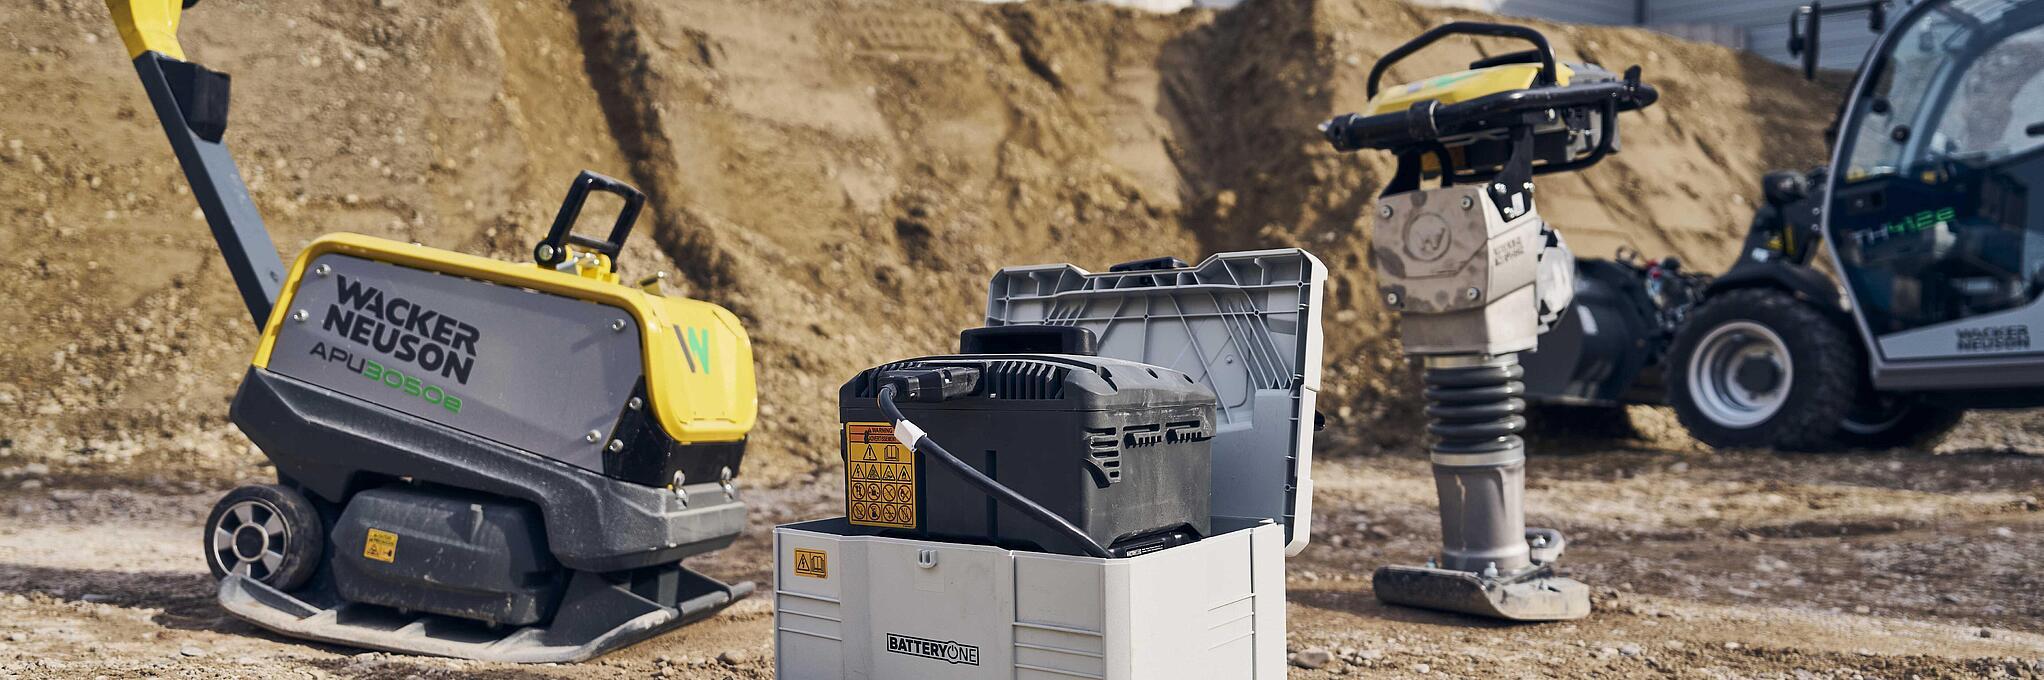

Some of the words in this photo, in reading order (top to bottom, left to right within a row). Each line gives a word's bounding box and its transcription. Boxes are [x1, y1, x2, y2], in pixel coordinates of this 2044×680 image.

[322, 303, 475, 386] NEUSON
[337, 274, 480, 357] WACKER
[309, 341, 463, 414] APU3050e
